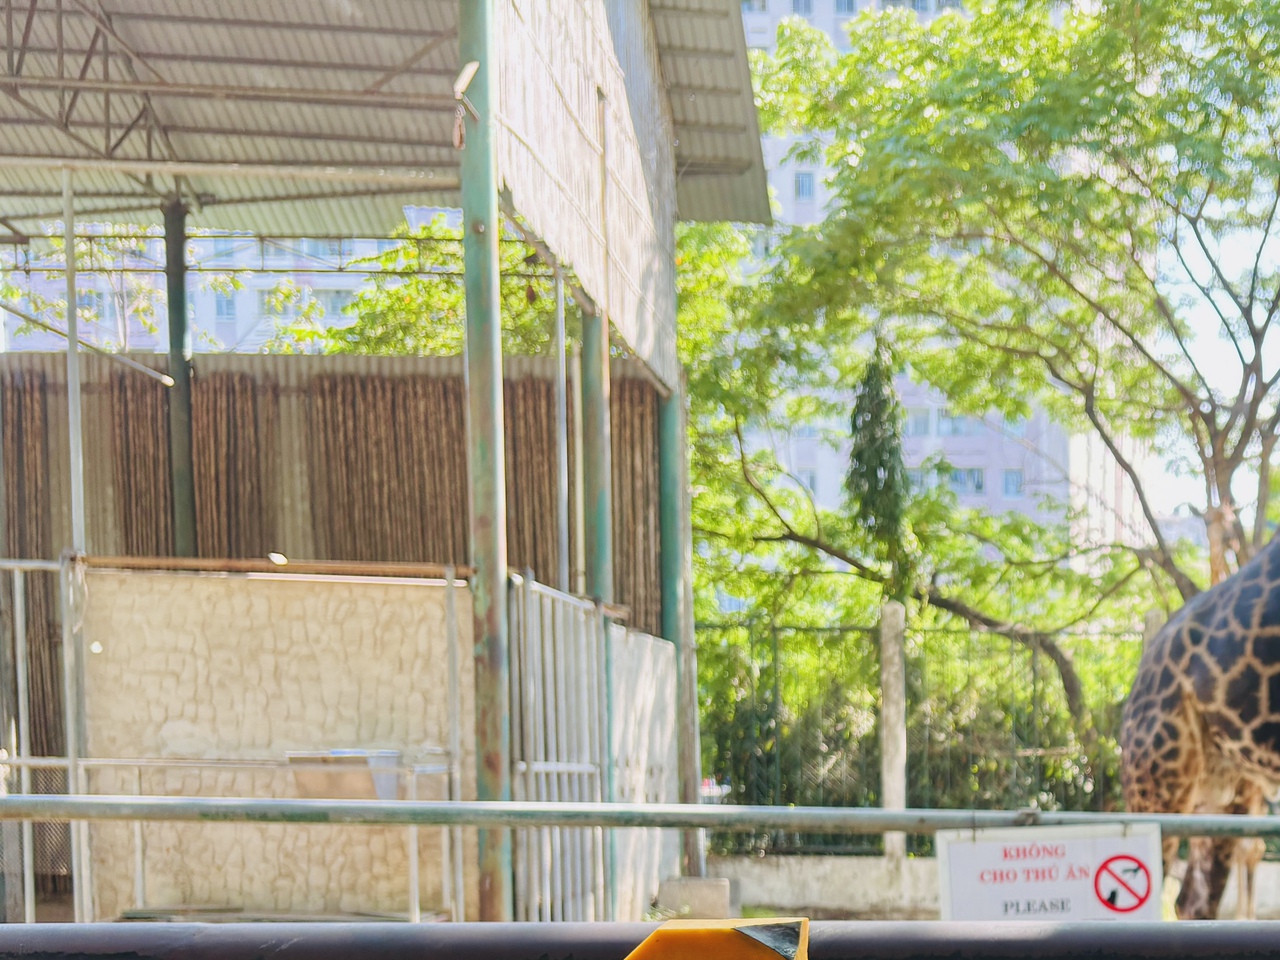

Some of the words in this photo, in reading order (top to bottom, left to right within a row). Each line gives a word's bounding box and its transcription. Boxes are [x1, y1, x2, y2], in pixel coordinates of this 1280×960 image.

[1002, 842, 1066, 861] KHÔNG
[979, 868, 1018, 884] CHO
[1022, 866, 1060, 883] THÚ
[1003, 898, 1071, 915] PLEASE
